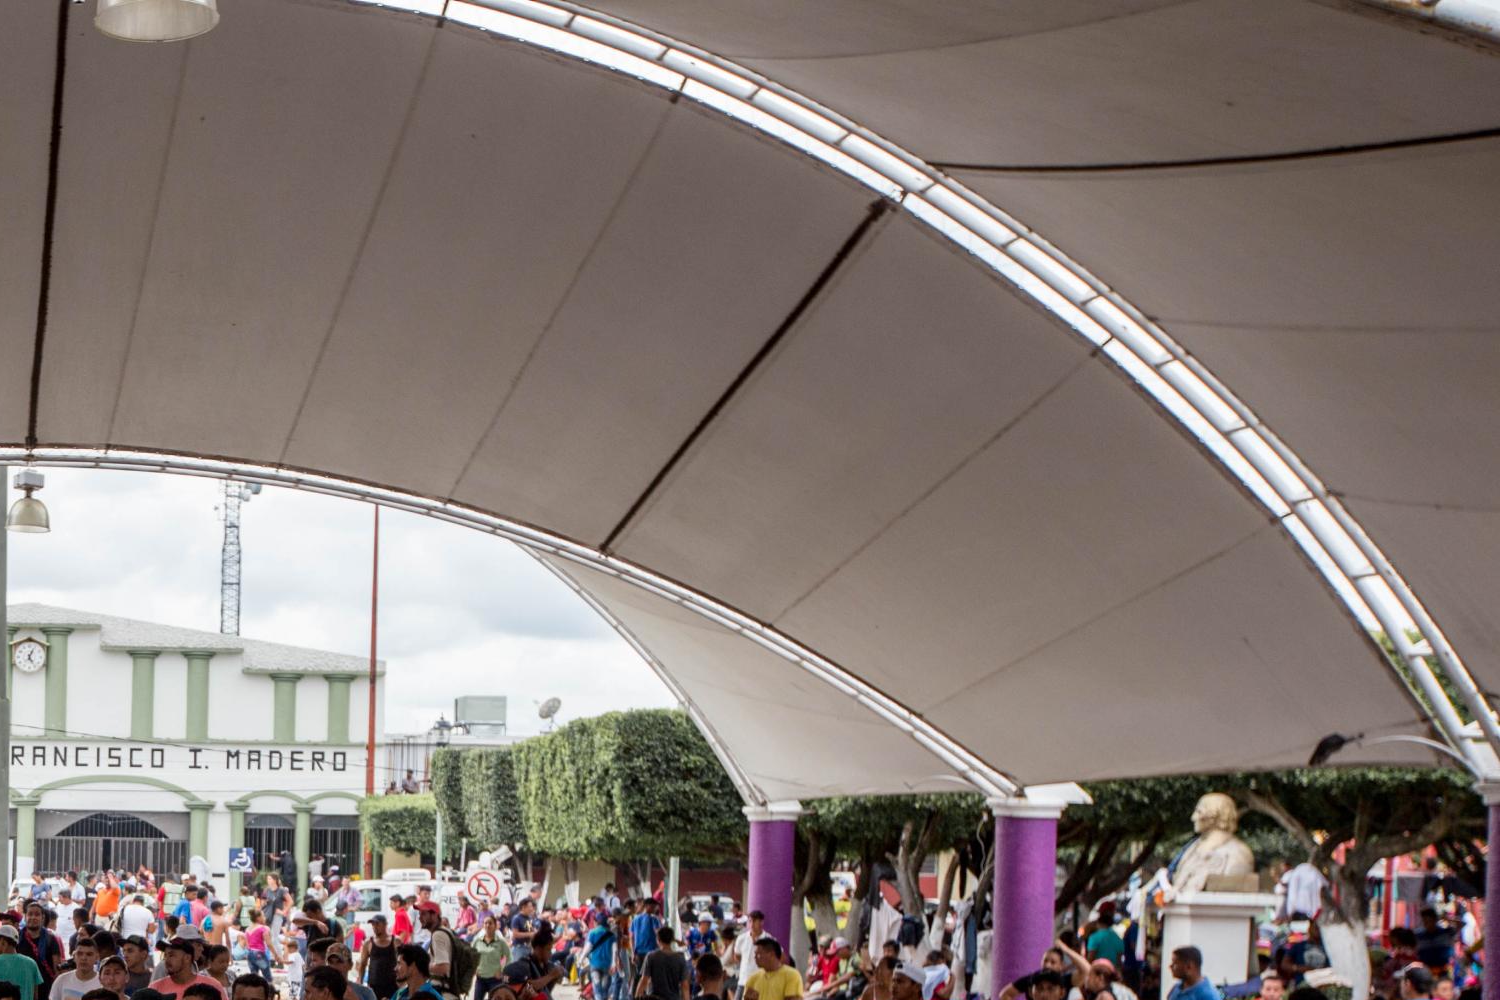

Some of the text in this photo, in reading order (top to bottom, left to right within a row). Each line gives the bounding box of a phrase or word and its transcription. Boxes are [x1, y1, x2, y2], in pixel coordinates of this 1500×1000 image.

[11, 745, 165, 768] RANCISCO
[188, 749, 209, 770] I.
[226, 750, 346, 771] MADERO
